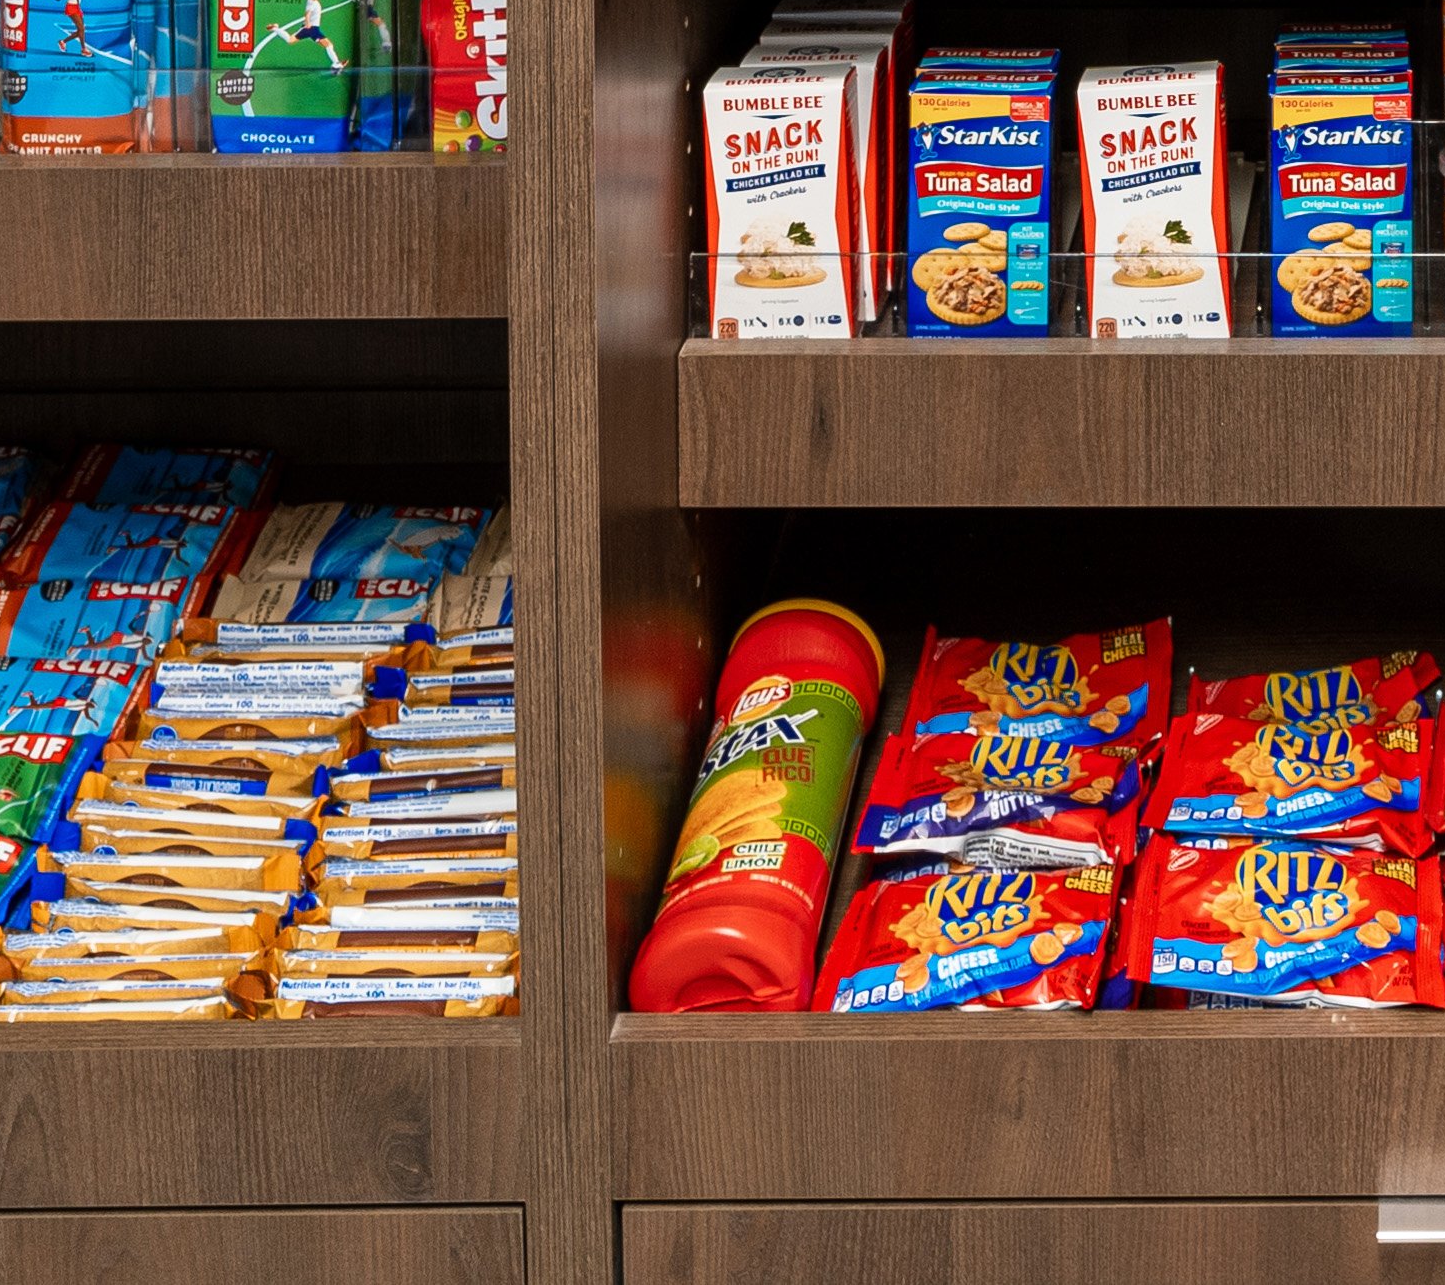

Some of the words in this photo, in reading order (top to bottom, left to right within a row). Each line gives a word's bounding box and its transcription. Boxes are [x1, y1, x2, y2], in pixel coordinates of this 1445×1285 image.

[222, 31, 250, 45] BAR
[724, 98, 790, 112] BUMBLE
[792, 96, 824, 110] BEE
[918, 98, 934, 107] 130
[936, 98, 971, 108] Calories
[1098, 97, 1157, 113] BUMBLE
[1162, 93, 1198, 109] BEE
[21, 133, 83, 146] CRUNCHY
[241, 132, 315, 145] CHOCOLATE
[724, 119, 823, 160] SNACK
[939, 125, 1040, 146] StarKist
[1100, 116, 1199, 157] SNACK
[732, 161, 751, 174] ON
[753, 155, 783, 171] THE
[786, 149, 819, 165] RUN!
[733, 176, 770, 190] CHICKEN
[773, 170, 803, 182] SALAD
[805, 167, 819, 177] KIT
[925, 173, 973, 193] Tuna
[977, 173, 1032, 193] Salad
[746, 192, 767, 204] with
[770, 185, 807, 199] Crackers
[937, 200, 974, 212] Original
[977, 202, 996, 211] Deli
[998, 202, 1020, 213] Style
[763, 748, 811, 765] QUE
[737, 844, 783, 854] CHILE
[1240, 851, 1349, 902] RITZ
[1265, 892, 1347, 935] bits
[281, 981, 322, 989] Nutrition
[325, 981, 350, 989] Facts
